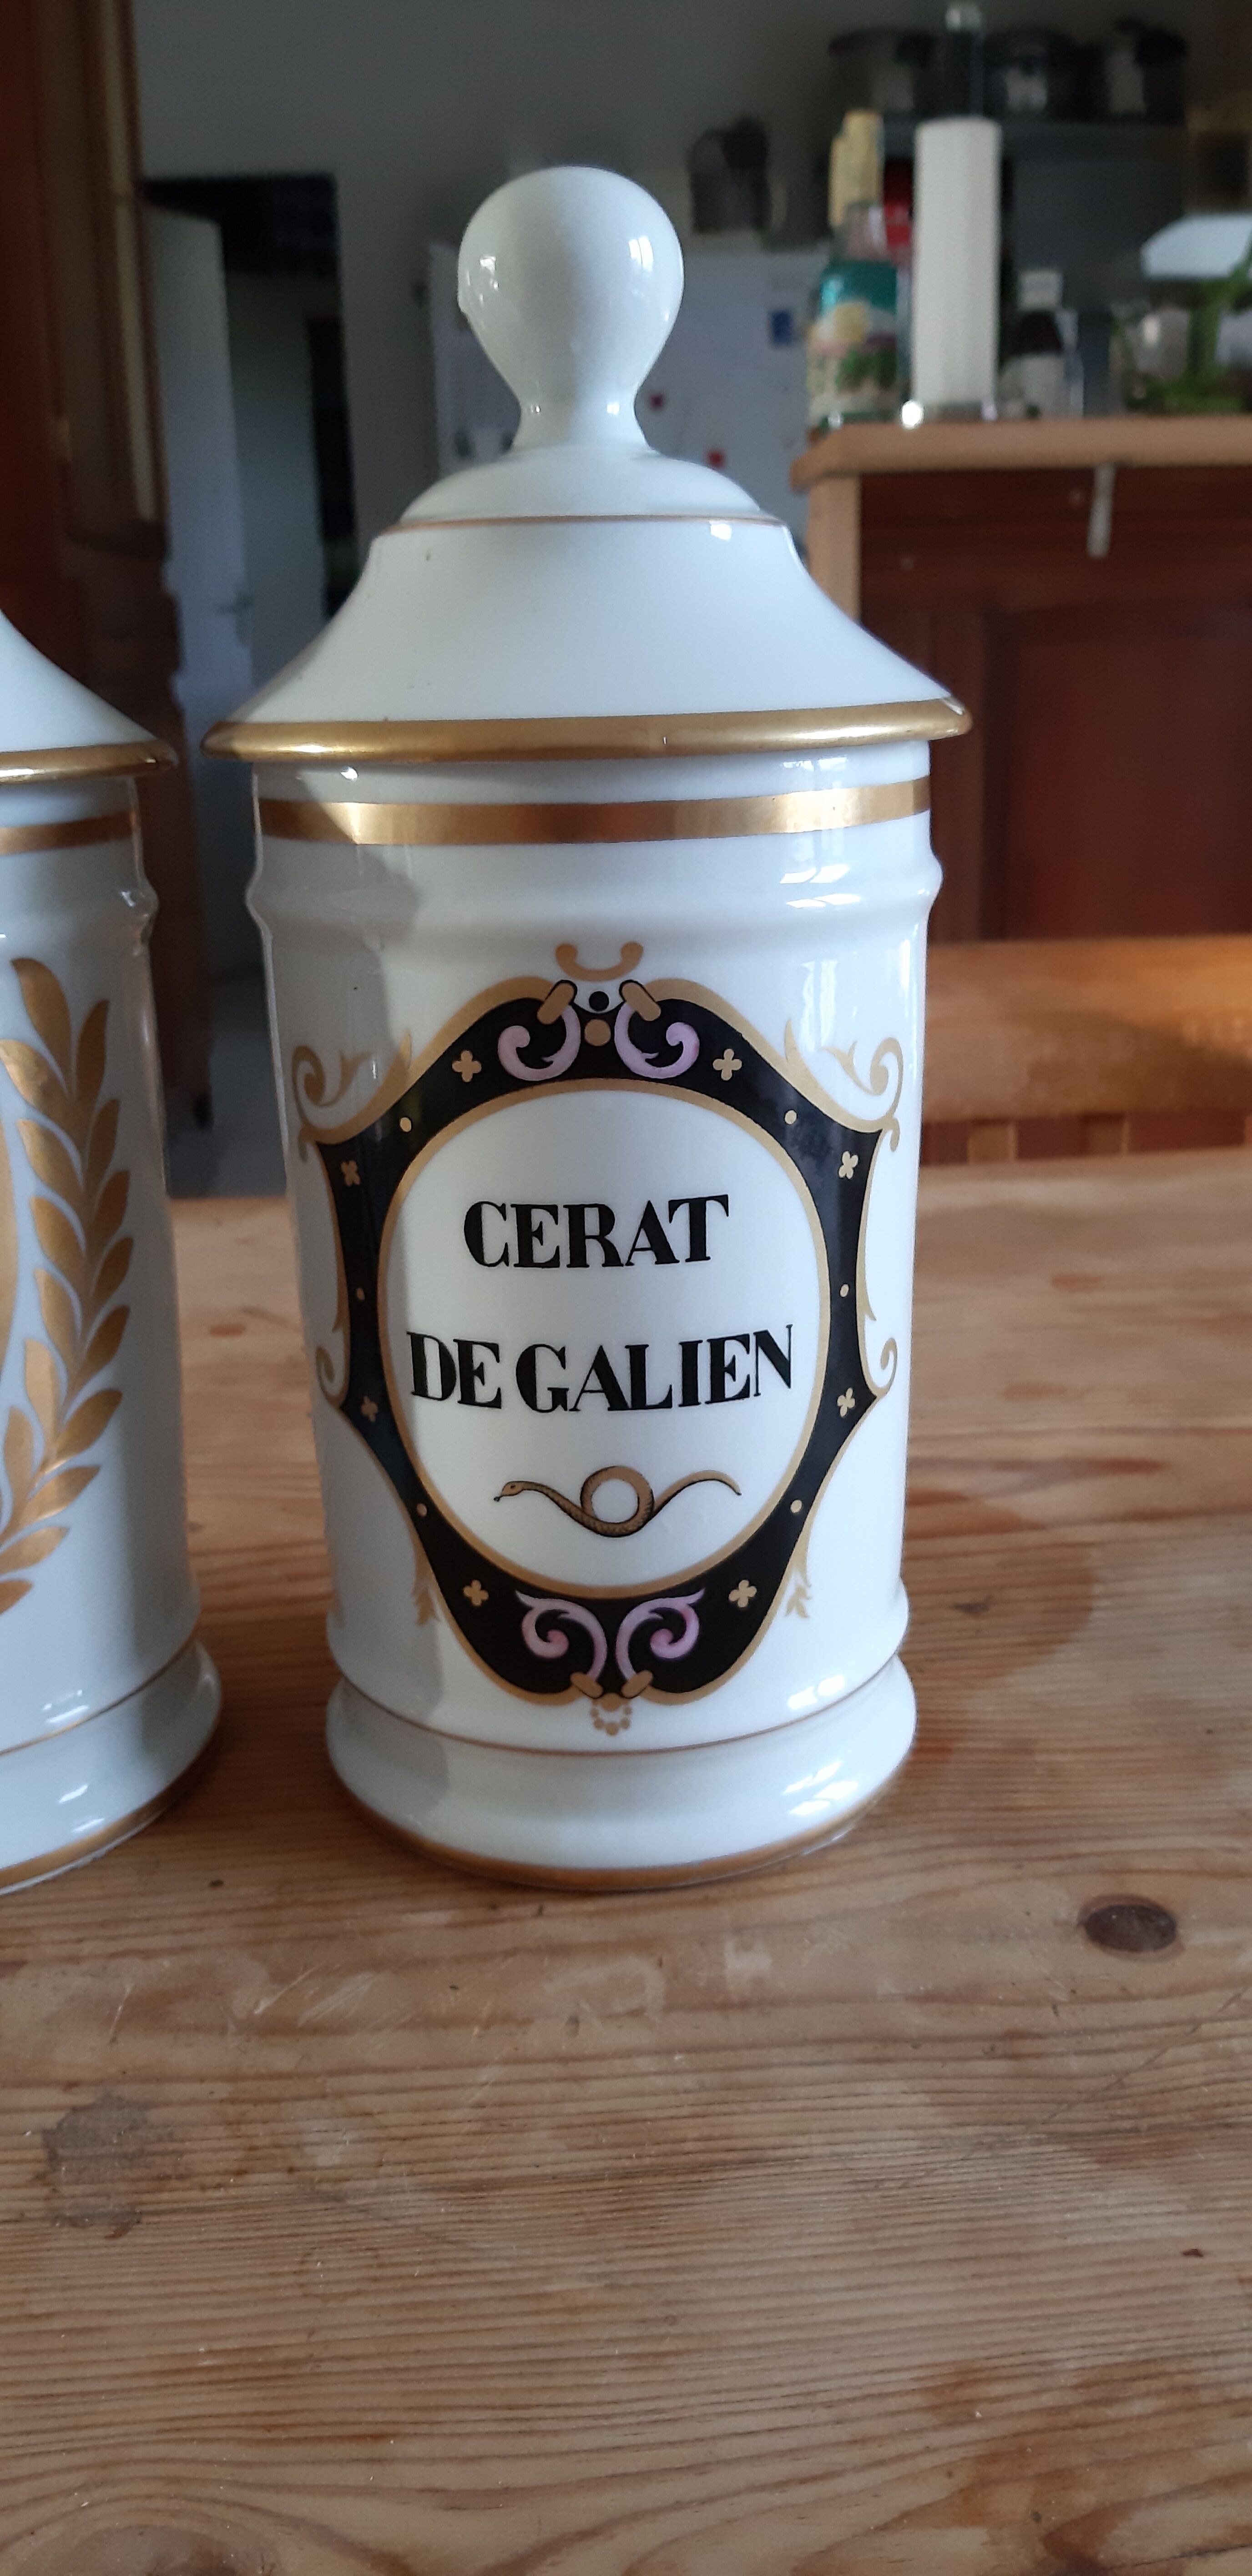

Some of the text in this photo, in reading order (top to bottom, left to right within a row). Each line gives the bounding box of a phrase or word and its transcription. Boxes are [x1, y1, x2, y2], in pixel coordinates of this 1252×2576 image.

[464, 1194, 729, 1268] CERAT
[406, 1324, 793, 1413] DE GALIEN
